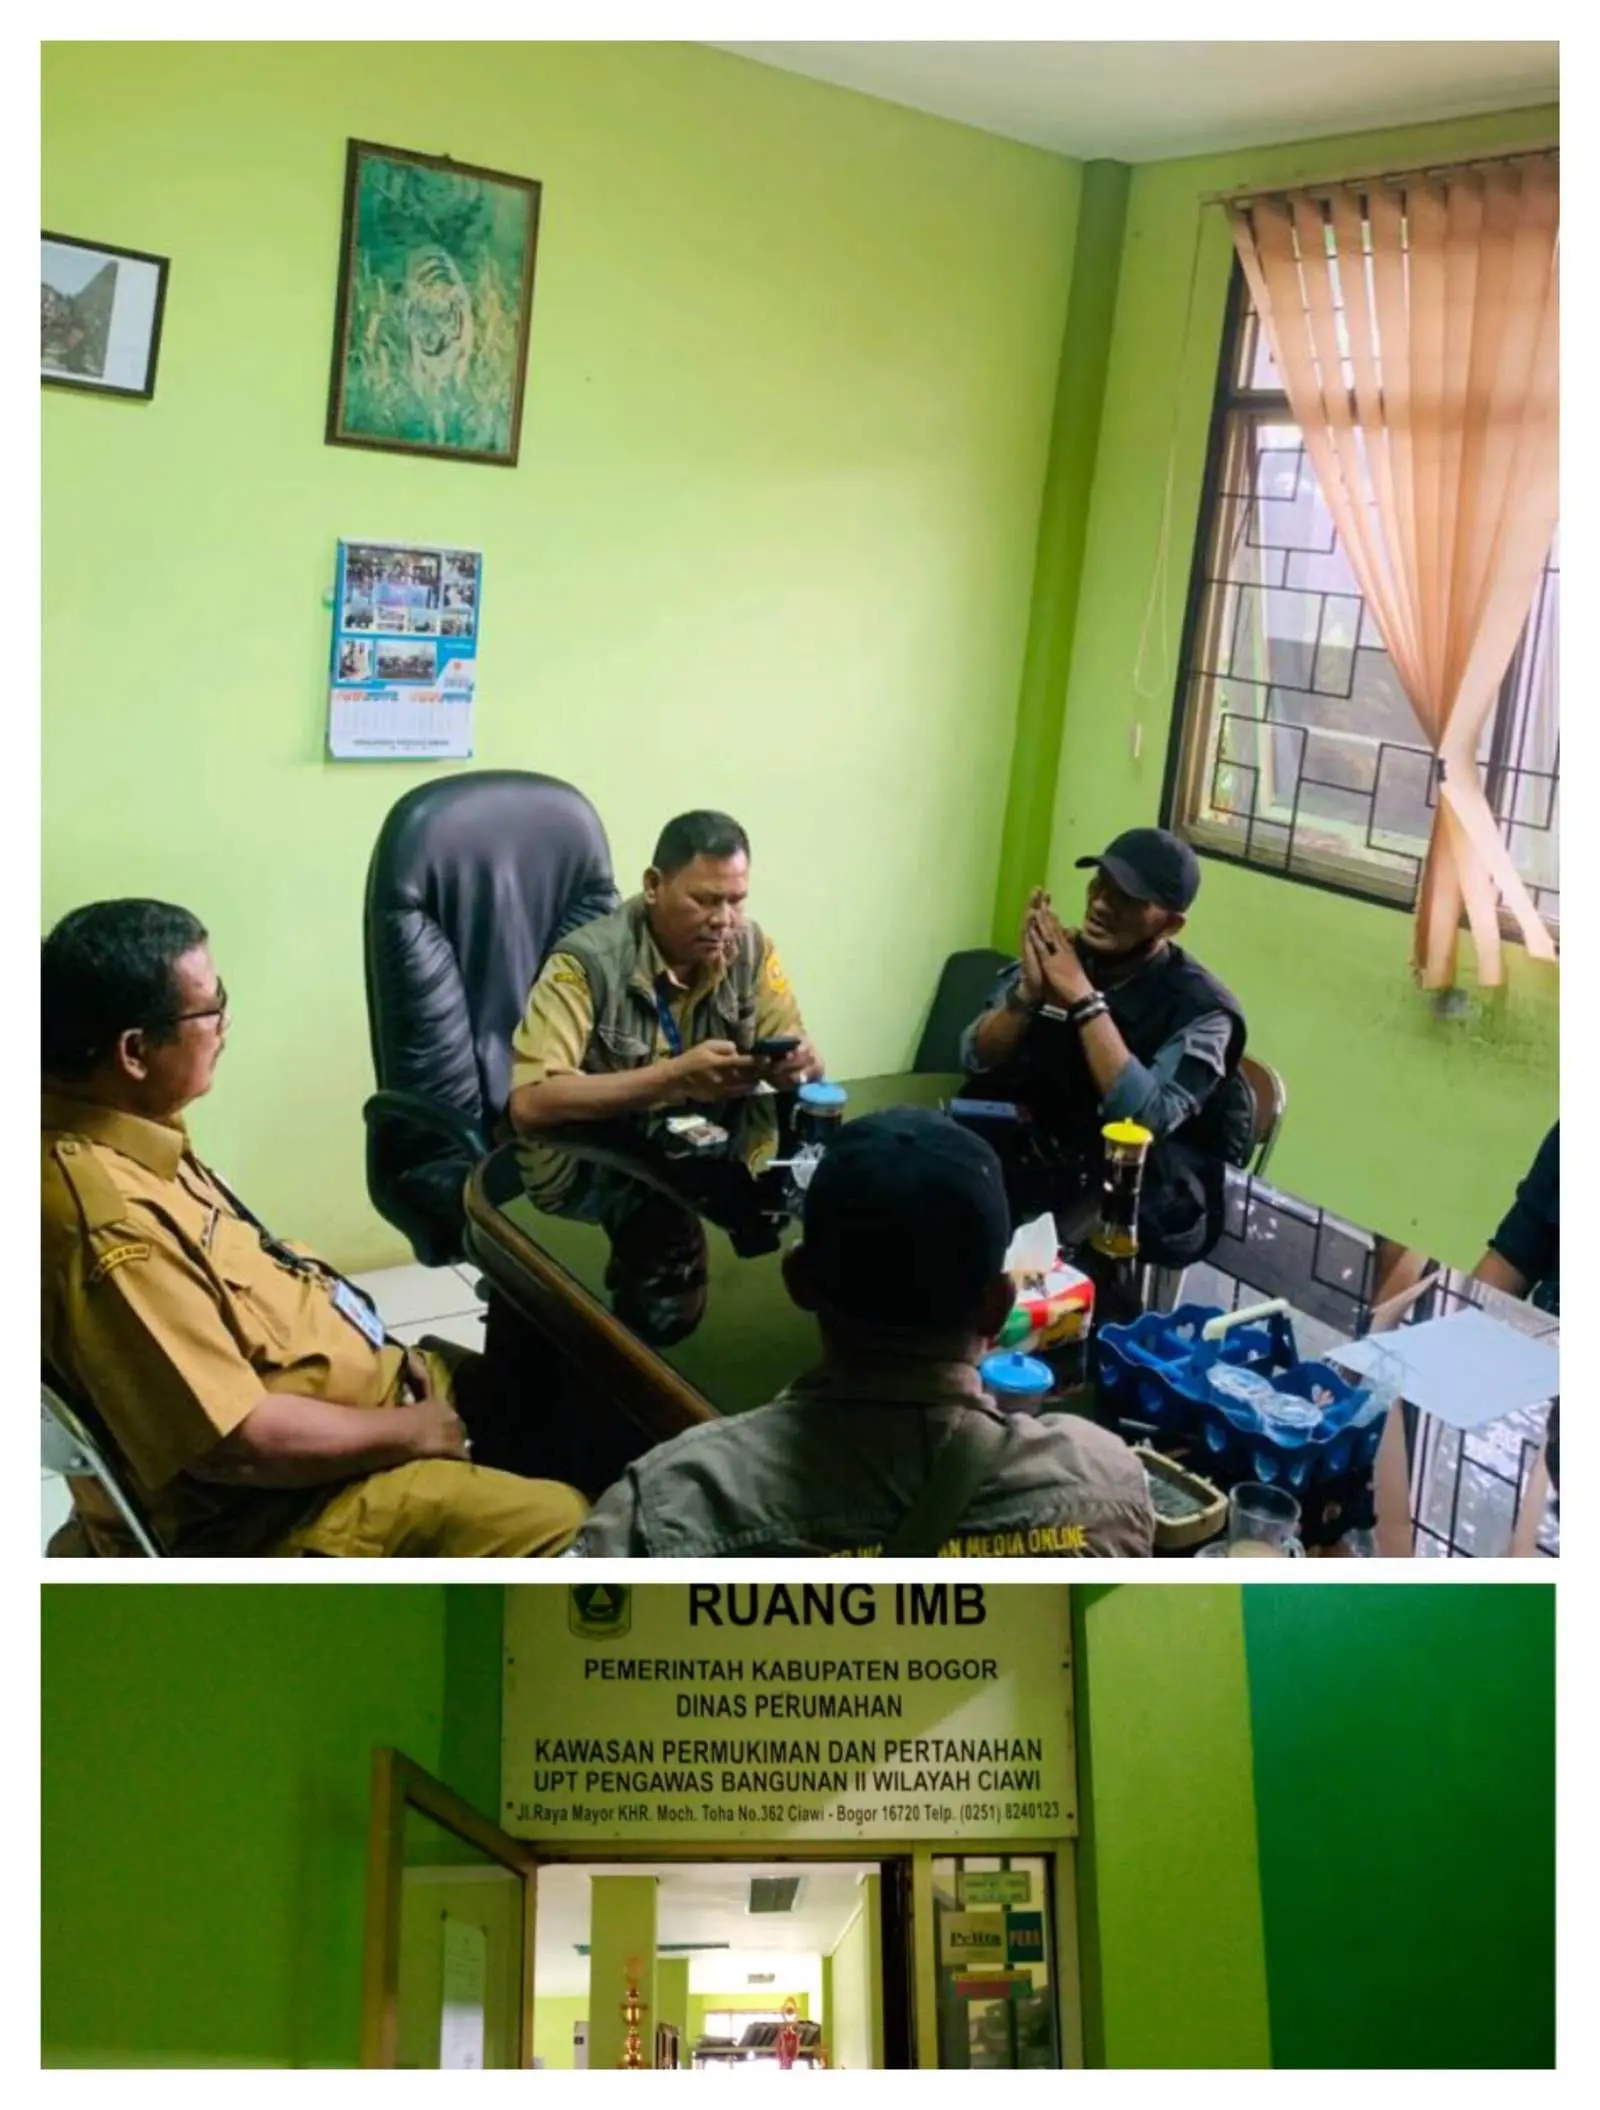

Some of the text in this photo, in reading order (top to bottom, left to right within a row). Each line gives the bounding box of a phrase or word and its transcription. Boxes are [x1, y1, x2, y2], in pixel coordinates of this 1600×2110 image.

[966, 1530, 1025, 1557] MEDIA
[1028, 1525, 1088, 1553] ONLINE
[690, 1584, 986, 1626] RUANG IMB
[585, 1659, 997, 1681] PEMERINTAH KABUPATEN BOGOR
[677, 1693, 901, 1718] DINAS PERUMAHAN
[536, 1739, 1041, 1764] KAWASAN PERMUKIMAN DAN PERTANAHAN
[534, 1770, 1040, 1792] UPT PENGAWAS BANGUNAN II WILAYAH CIAWI
[572, 1804, 614, 1825] Mayor
[657, 1805, 696, 1821] Moch.
[702, 1804, 734, 1821] Toha
[738, 1805, 784, 1821] No.362
[788, 1804, 825, 1822] Ciawi
[837, 1805, 877, 1826] Bogor
[883, 1805, 920, 1821] 16720
[924, 1804, 955, 1823] Telp.
[960, 1804, 1001, 1823] (0251)
[1005, 1801, 1059, 1820] 8240123
